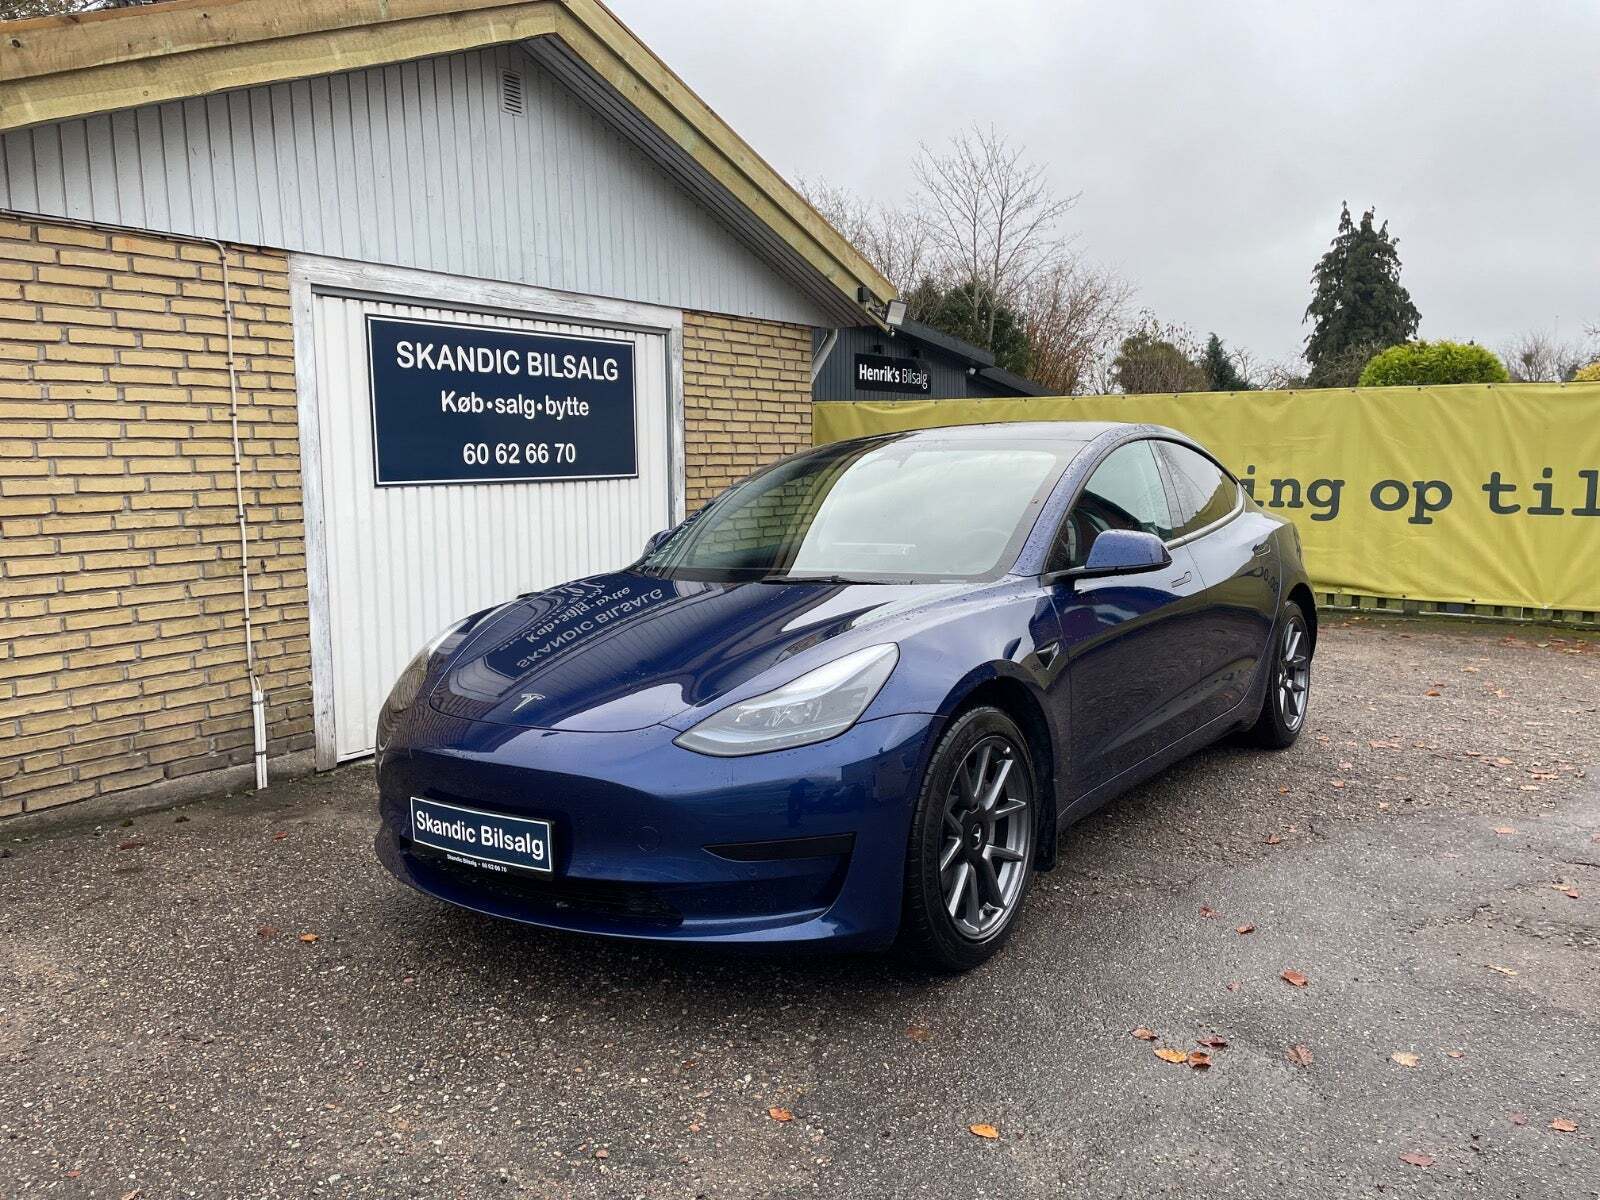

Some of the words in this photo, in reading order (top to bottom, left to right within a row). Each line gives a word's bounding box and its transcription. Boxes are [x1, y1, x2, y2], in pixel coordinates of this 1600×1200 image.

[396, 341, 520, 375] SKANDIC
[527, 351, 619, 381] BILSALG
[901, 368, 928, 390] Bilsalg
[463, 443, 489, 465] 60
[495, 443, 520, 464] 62
[525, 443, 550, 464] 66
[555, 443, 576, 464] 70
[1370, 479, 1453, 525] op
[1482, 467, 1600, 517] til
[416, 810, 476, 844] Skandic
[480, 825, 544, 861] Bilsalg
